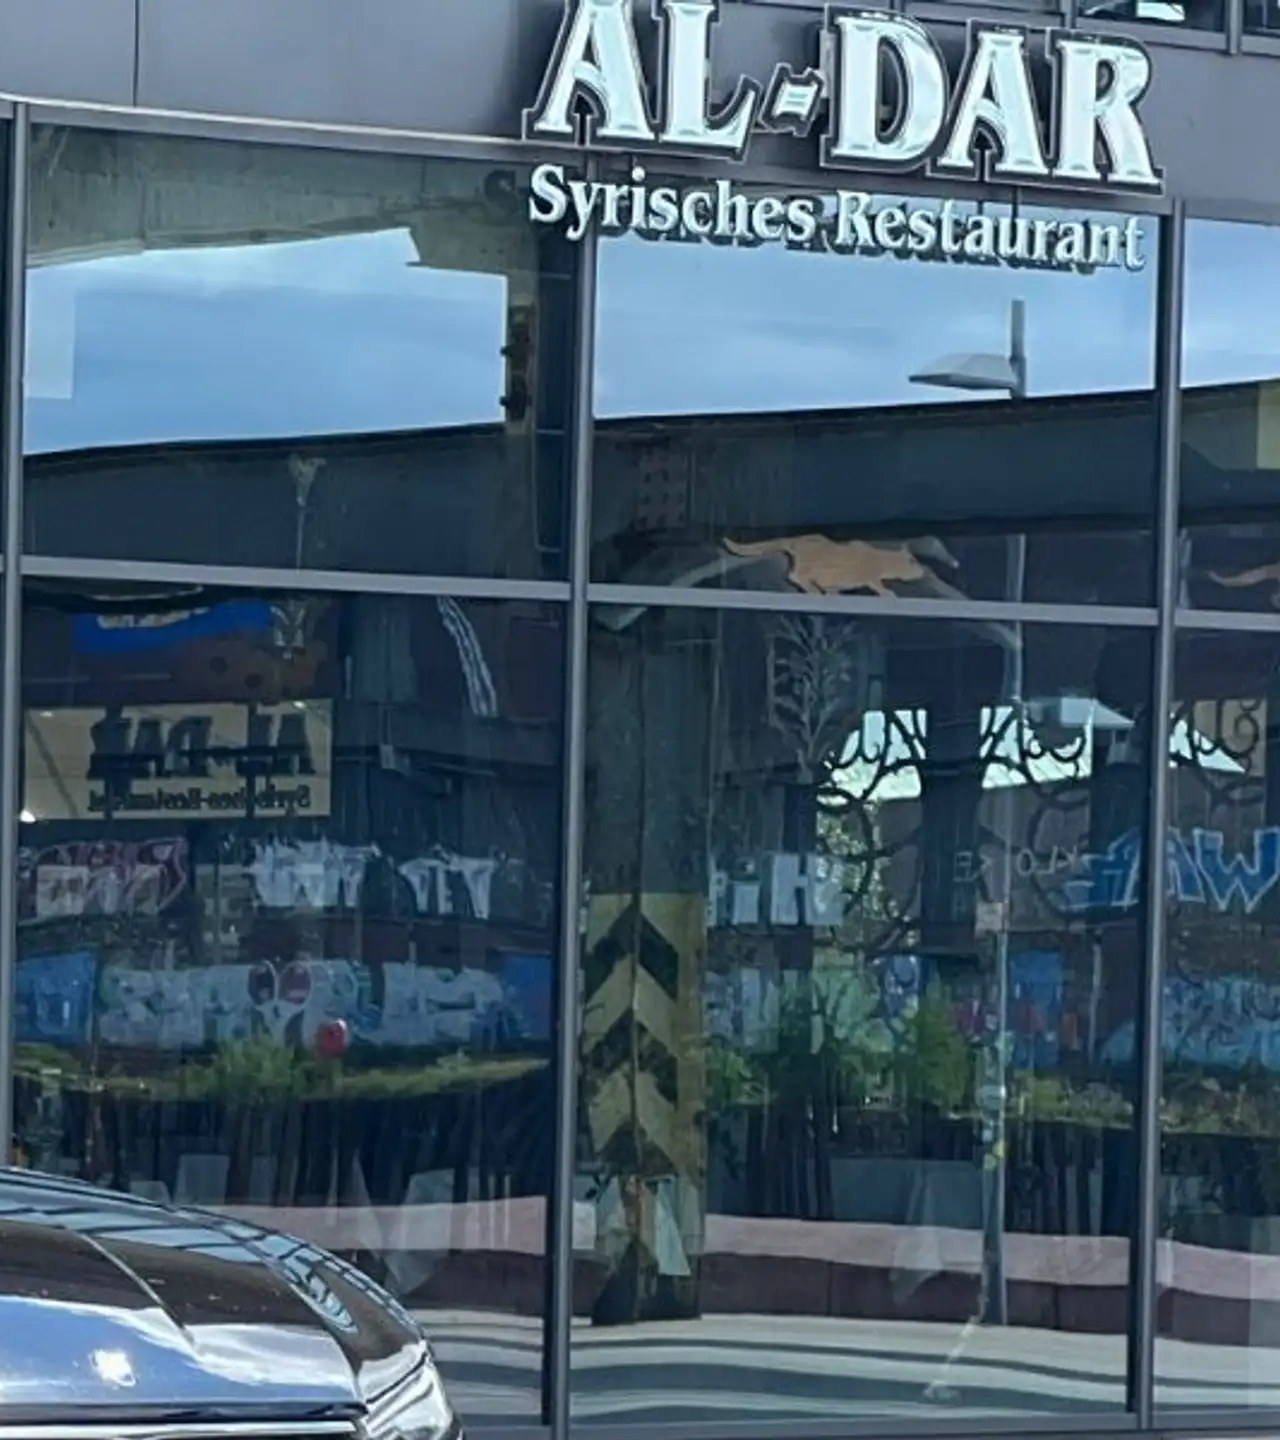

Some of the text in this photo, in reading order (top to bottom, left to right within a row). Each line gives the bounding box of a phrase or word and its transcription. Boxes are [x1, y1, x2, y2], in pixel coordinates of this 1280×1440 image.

[525, 0, 1162, 190] AL-DAR
[529, 163, 1145, 270] Syrisches Restaurant
